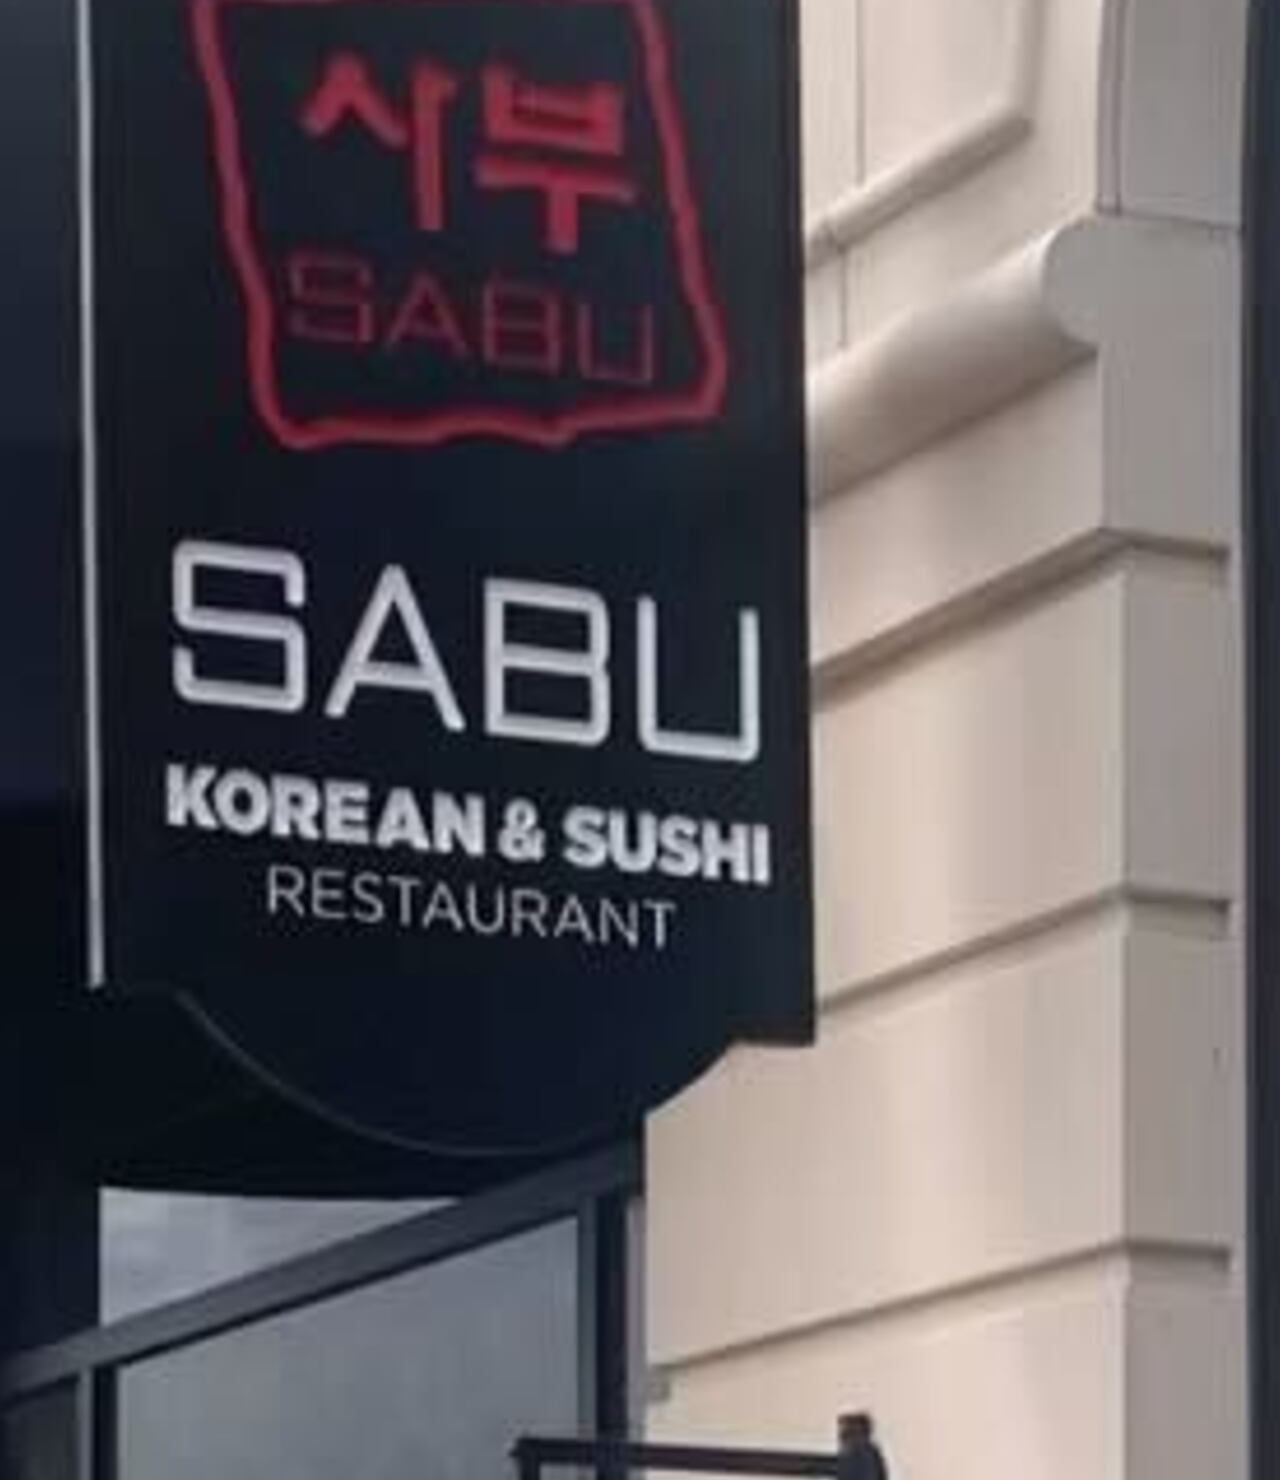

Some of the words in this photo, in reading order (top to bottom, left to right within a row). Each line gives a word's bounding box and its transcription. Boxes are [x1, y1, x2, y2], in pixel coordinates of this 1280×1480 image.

[300, 52, 636, 257] 사부
[286, 253, 656, 386] SABU
[172, 539, 760, 763] SABU
[166, 763, 486, 857] KOREAN
[498, 801, 545, 863] &
[563, 805, 772, 886] SUSHI
[266, 864, 678, 950] RESTAURANT
